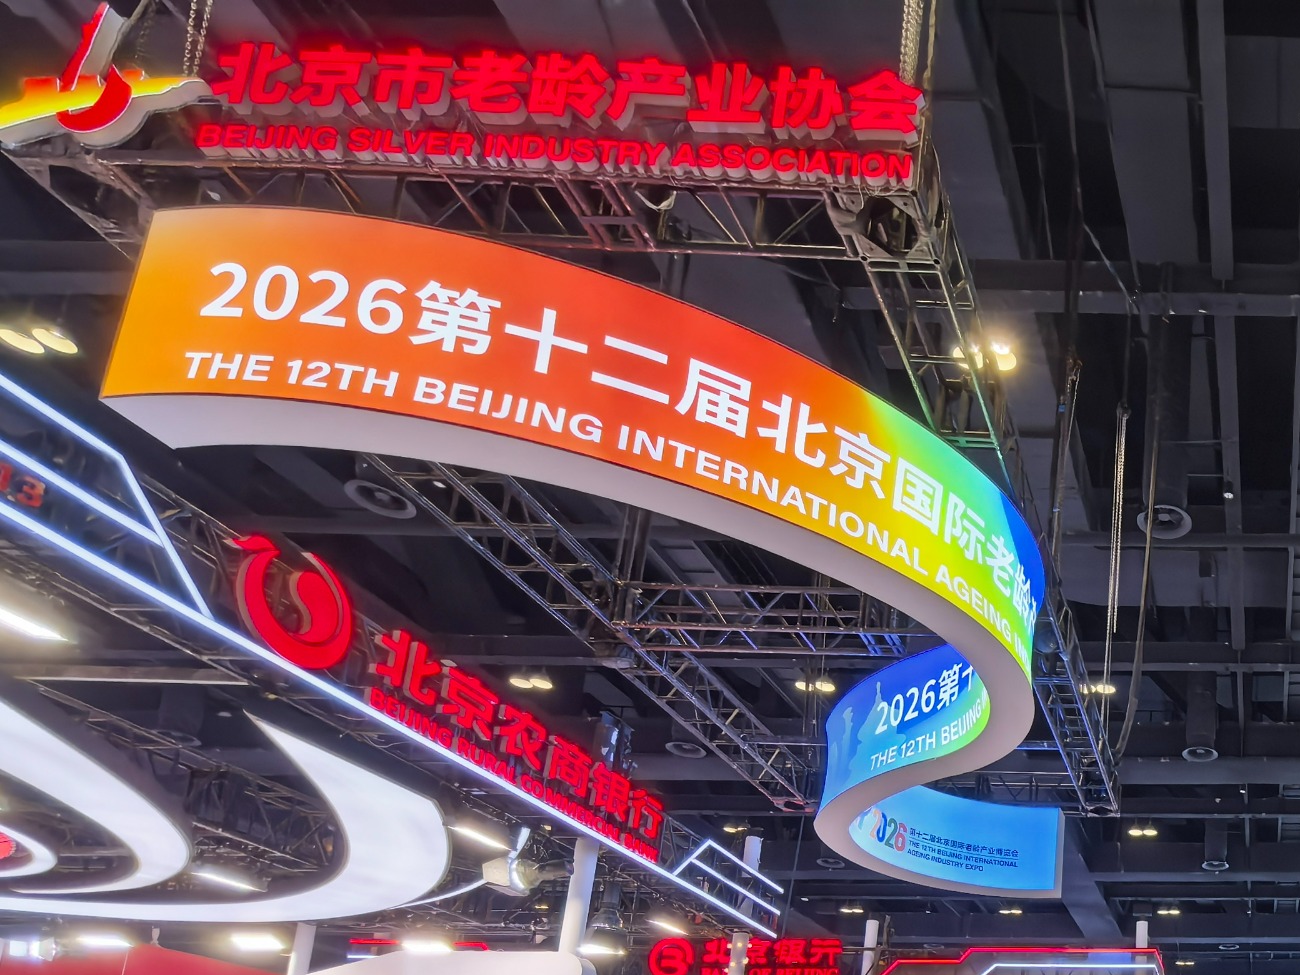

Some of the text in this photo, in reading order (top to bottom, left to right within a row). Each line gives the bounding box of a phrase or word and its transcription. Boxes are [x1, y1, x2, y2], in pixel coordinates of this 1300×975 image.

[211, 42, 924, 134] 北京市老龄产业协会
[196, 124, 914, 180] BEIJING SILVER INDUSTRY ASSOCIATION
[184, 351, 272, 383] THE
[286, 359, 399, 397] 12TH
[412, 379, 604, 443] BEIJING
[618, 424, 929, 577] INTERNATIONAL
[936, 565, 1013, 645] AGEING
[369, 686, 453, 748] BEIJING
[457, 736, 517, 785] RURAL
[375, 629, 664, 840] 北京农商银行
[870, 749, 898, 770] THE
[900, 732, 937, 759] 12TH
[870, 808, 908, 853] 2026
